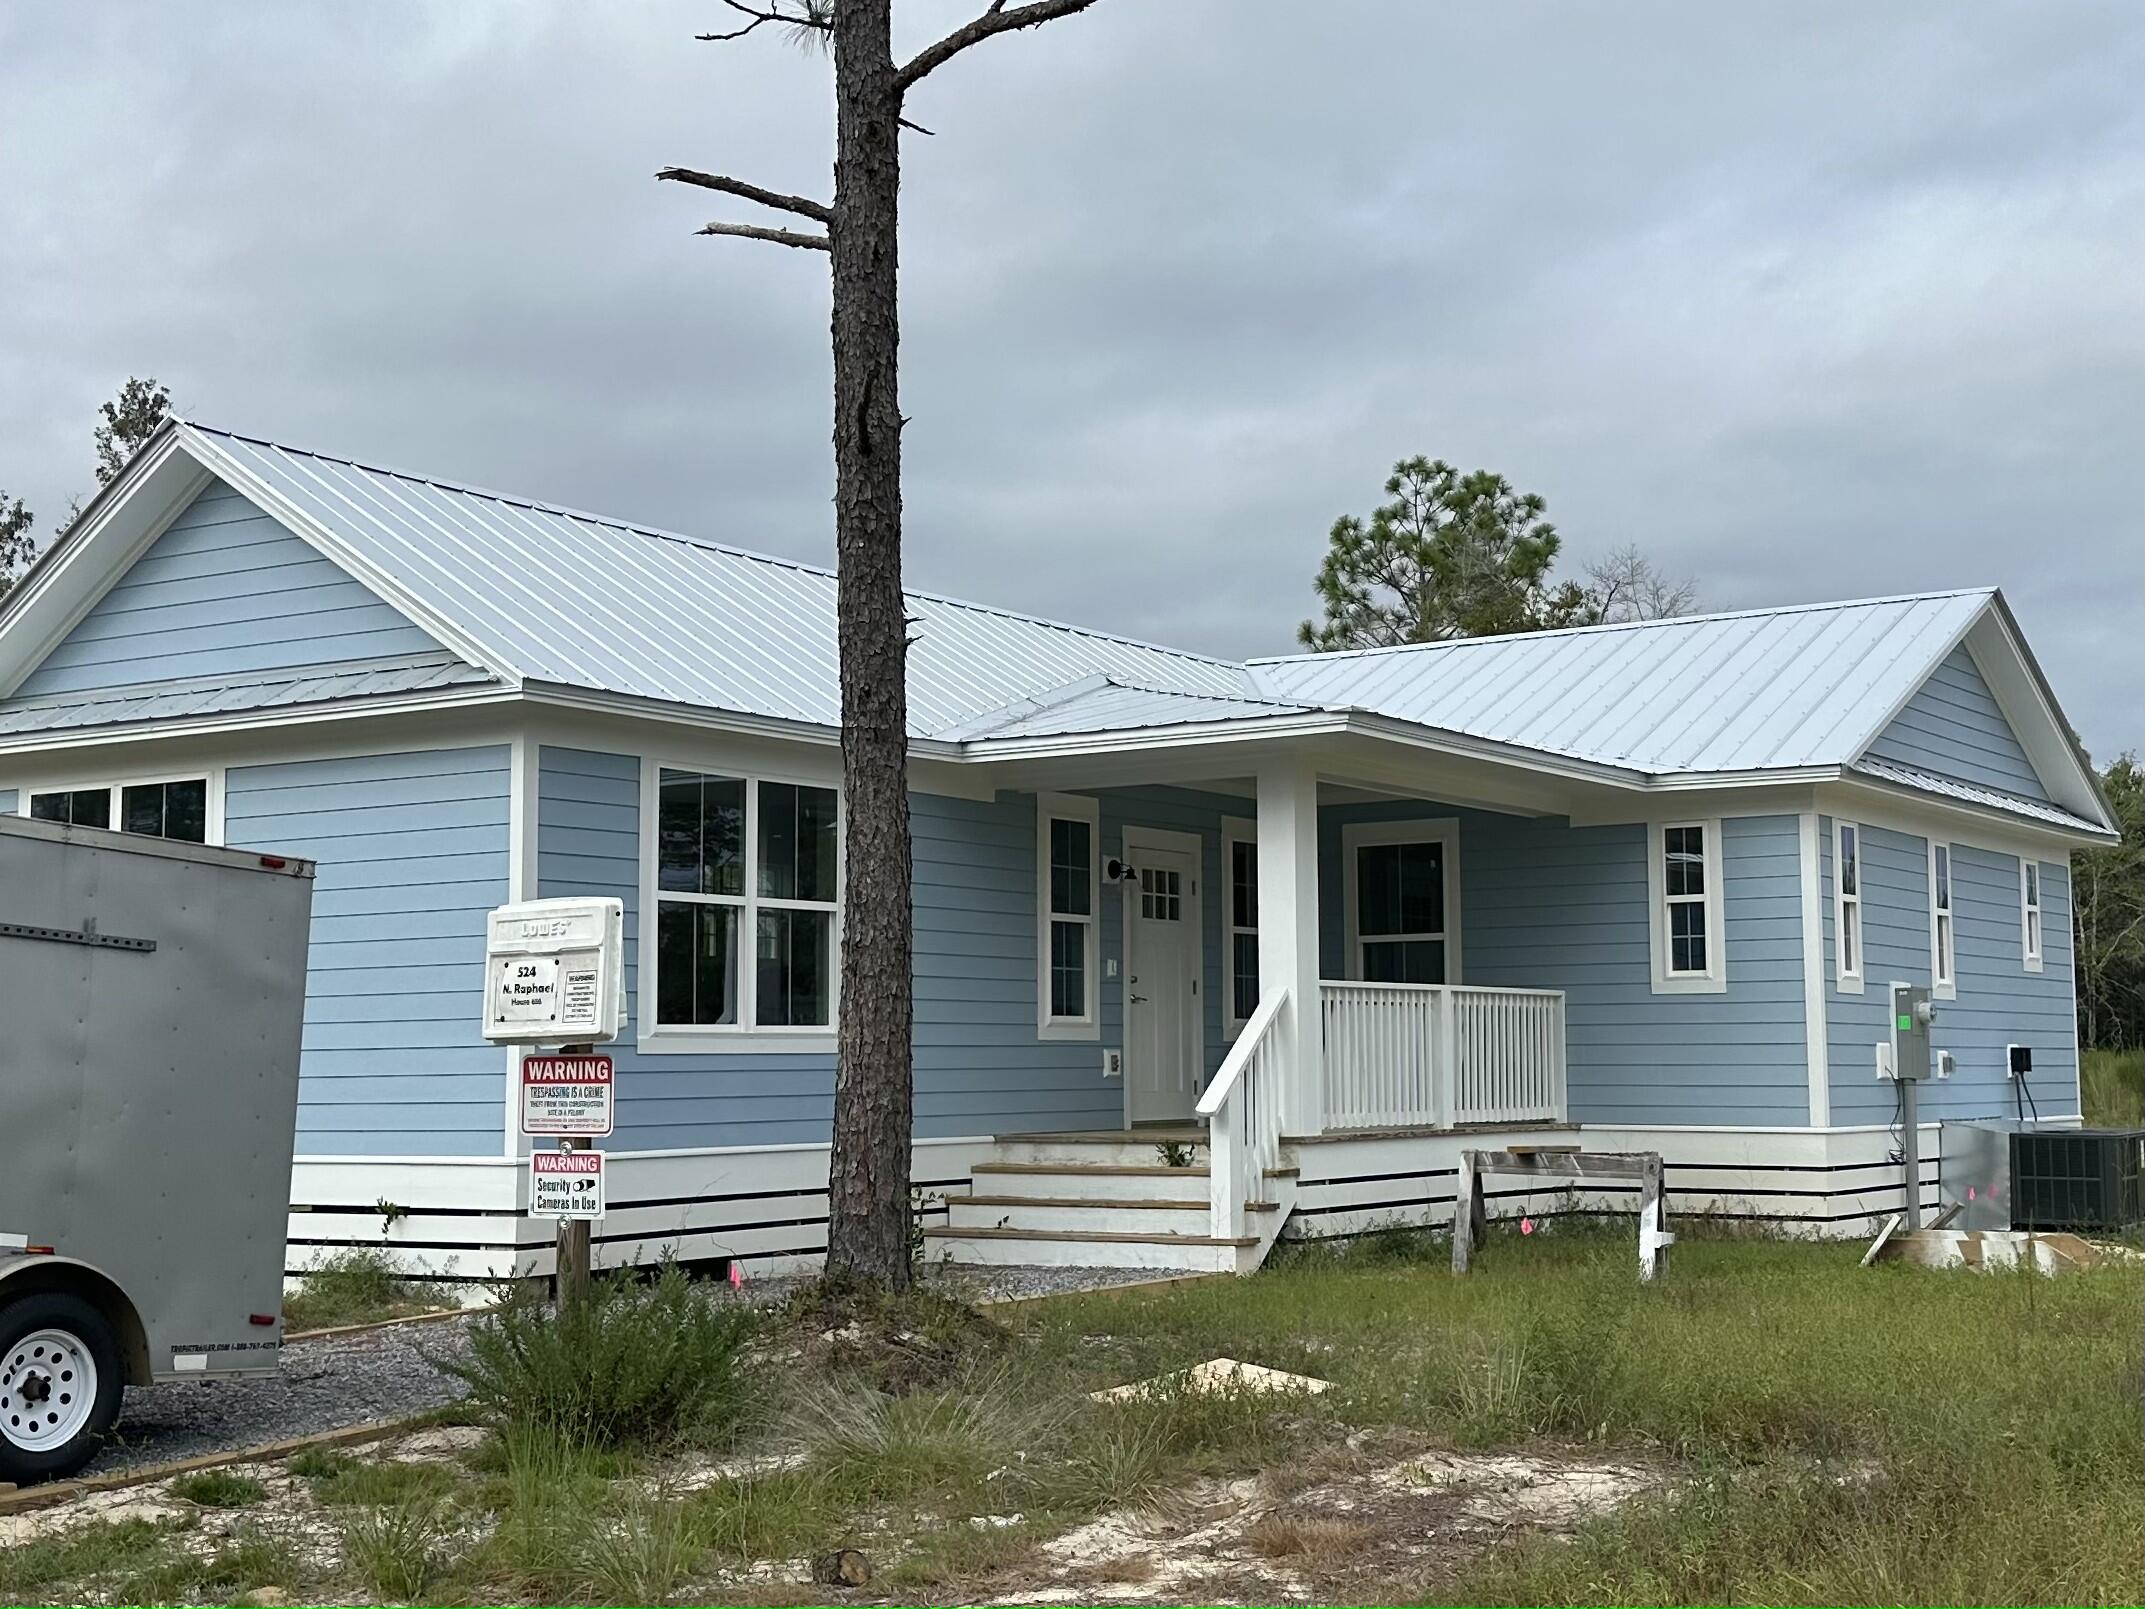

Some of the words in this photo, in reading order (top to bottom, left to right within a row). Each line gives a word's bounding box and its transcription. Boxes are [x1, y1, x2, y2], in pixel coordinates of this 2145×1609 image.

[517, 966, 537, 978] 524
[503, 984, 512, 994] N.
[514, 982, 554, 995] Raphael
[528, 1061, 609, 1081] WARNING
[530, 1086, 570, 1098] TRESPASSING
[571, 1086, 578, 1098] IS
[579, 1086, 583, 1098] A
[584, 1086, 604, 1098] CRIME
[537, 1156, 598, 1171] WARNING
[537, 1177, 571, 1195] Security
[537, 1195, 570, 1209] Cameras
[572, 1196, 580, 1209] In
[582, 1196, 596, 1210] Use
